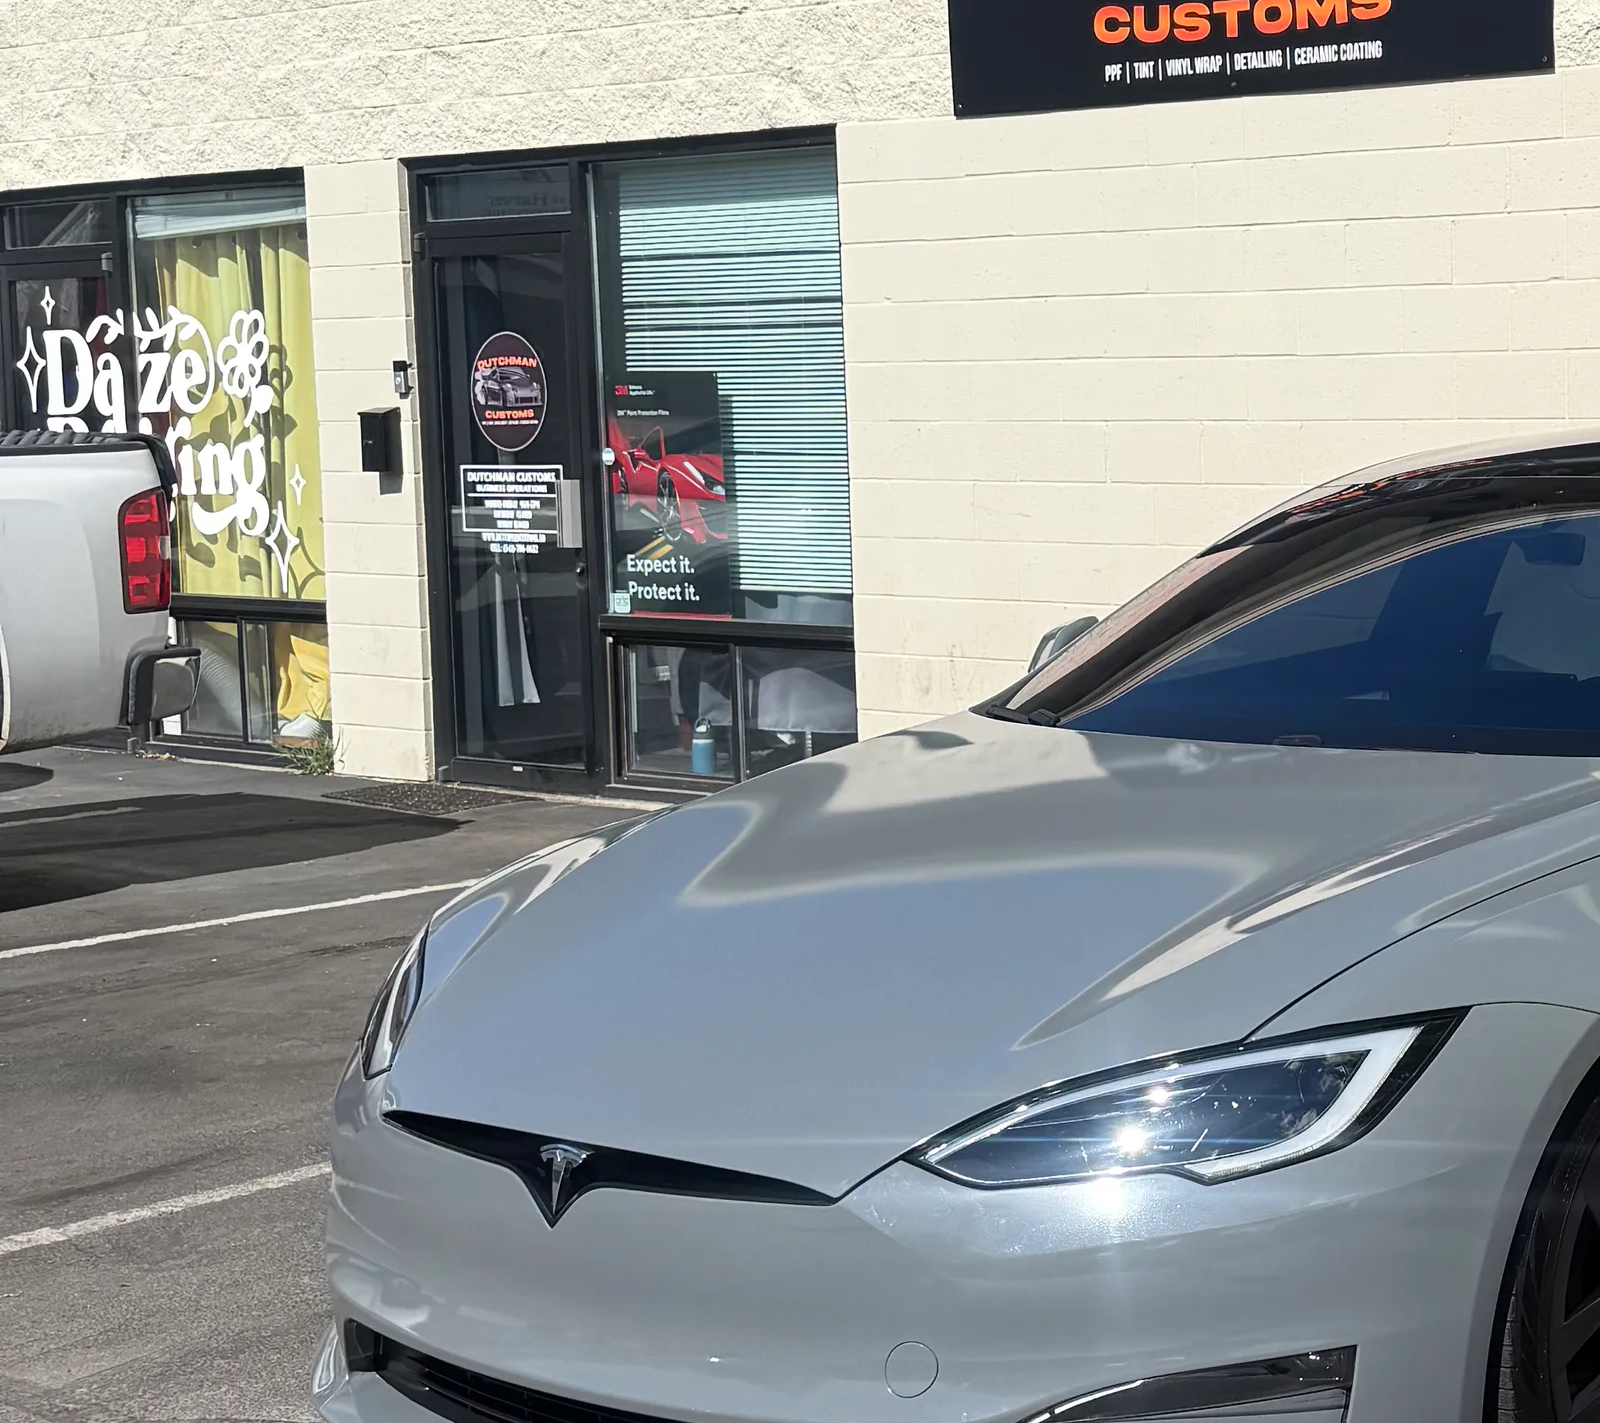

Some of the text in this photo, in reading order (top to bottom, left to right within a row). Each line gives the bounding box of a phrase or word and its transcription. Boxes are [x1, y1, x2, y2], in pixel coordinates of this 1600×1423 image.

[1105, 40, 1383, 82] PPF TINT VINYL WRAP DETAILING CERAMIC COATING
[43, 314, 215, 418] Daze
[477, 356, 538, 370] DUTCHMAN
[485, 409, 534, 419] CUSTOMS
[626, 554, 695, 577] Expect it.
[628, 580, 700, 601] Protect it.
